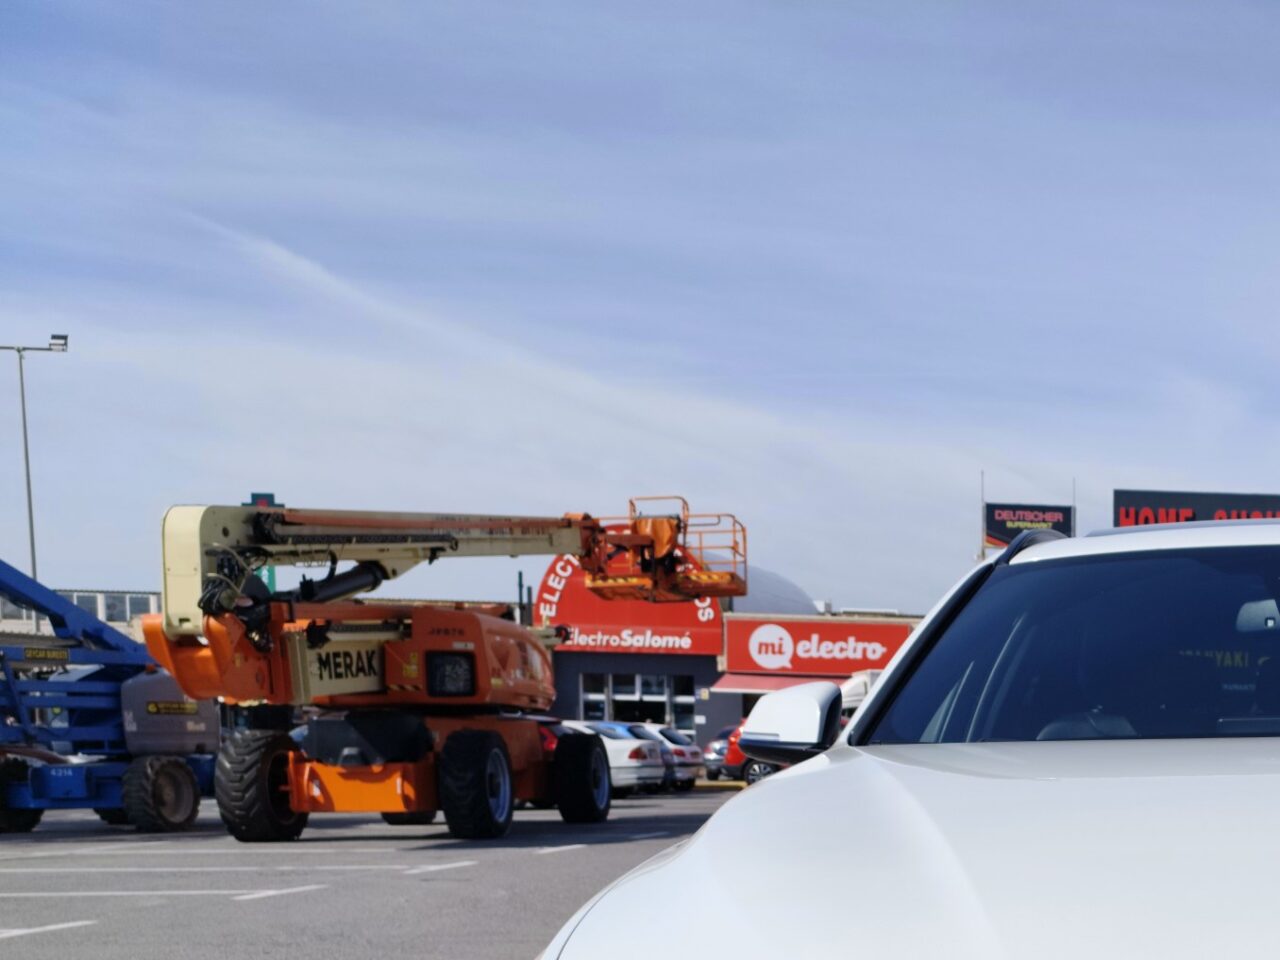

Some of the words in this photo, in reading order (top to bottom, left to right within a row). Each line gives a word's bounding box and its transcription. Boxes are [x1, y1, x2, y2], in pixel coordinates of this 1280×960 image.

[994, 509, 1063, 522] DEUTSCHER
[1118, 506, 1194, 528] HOME
[758, 637, 785, 656] mi
[796, 633, 887, 660] electro
[317, 651, 377, 680] MERAK
